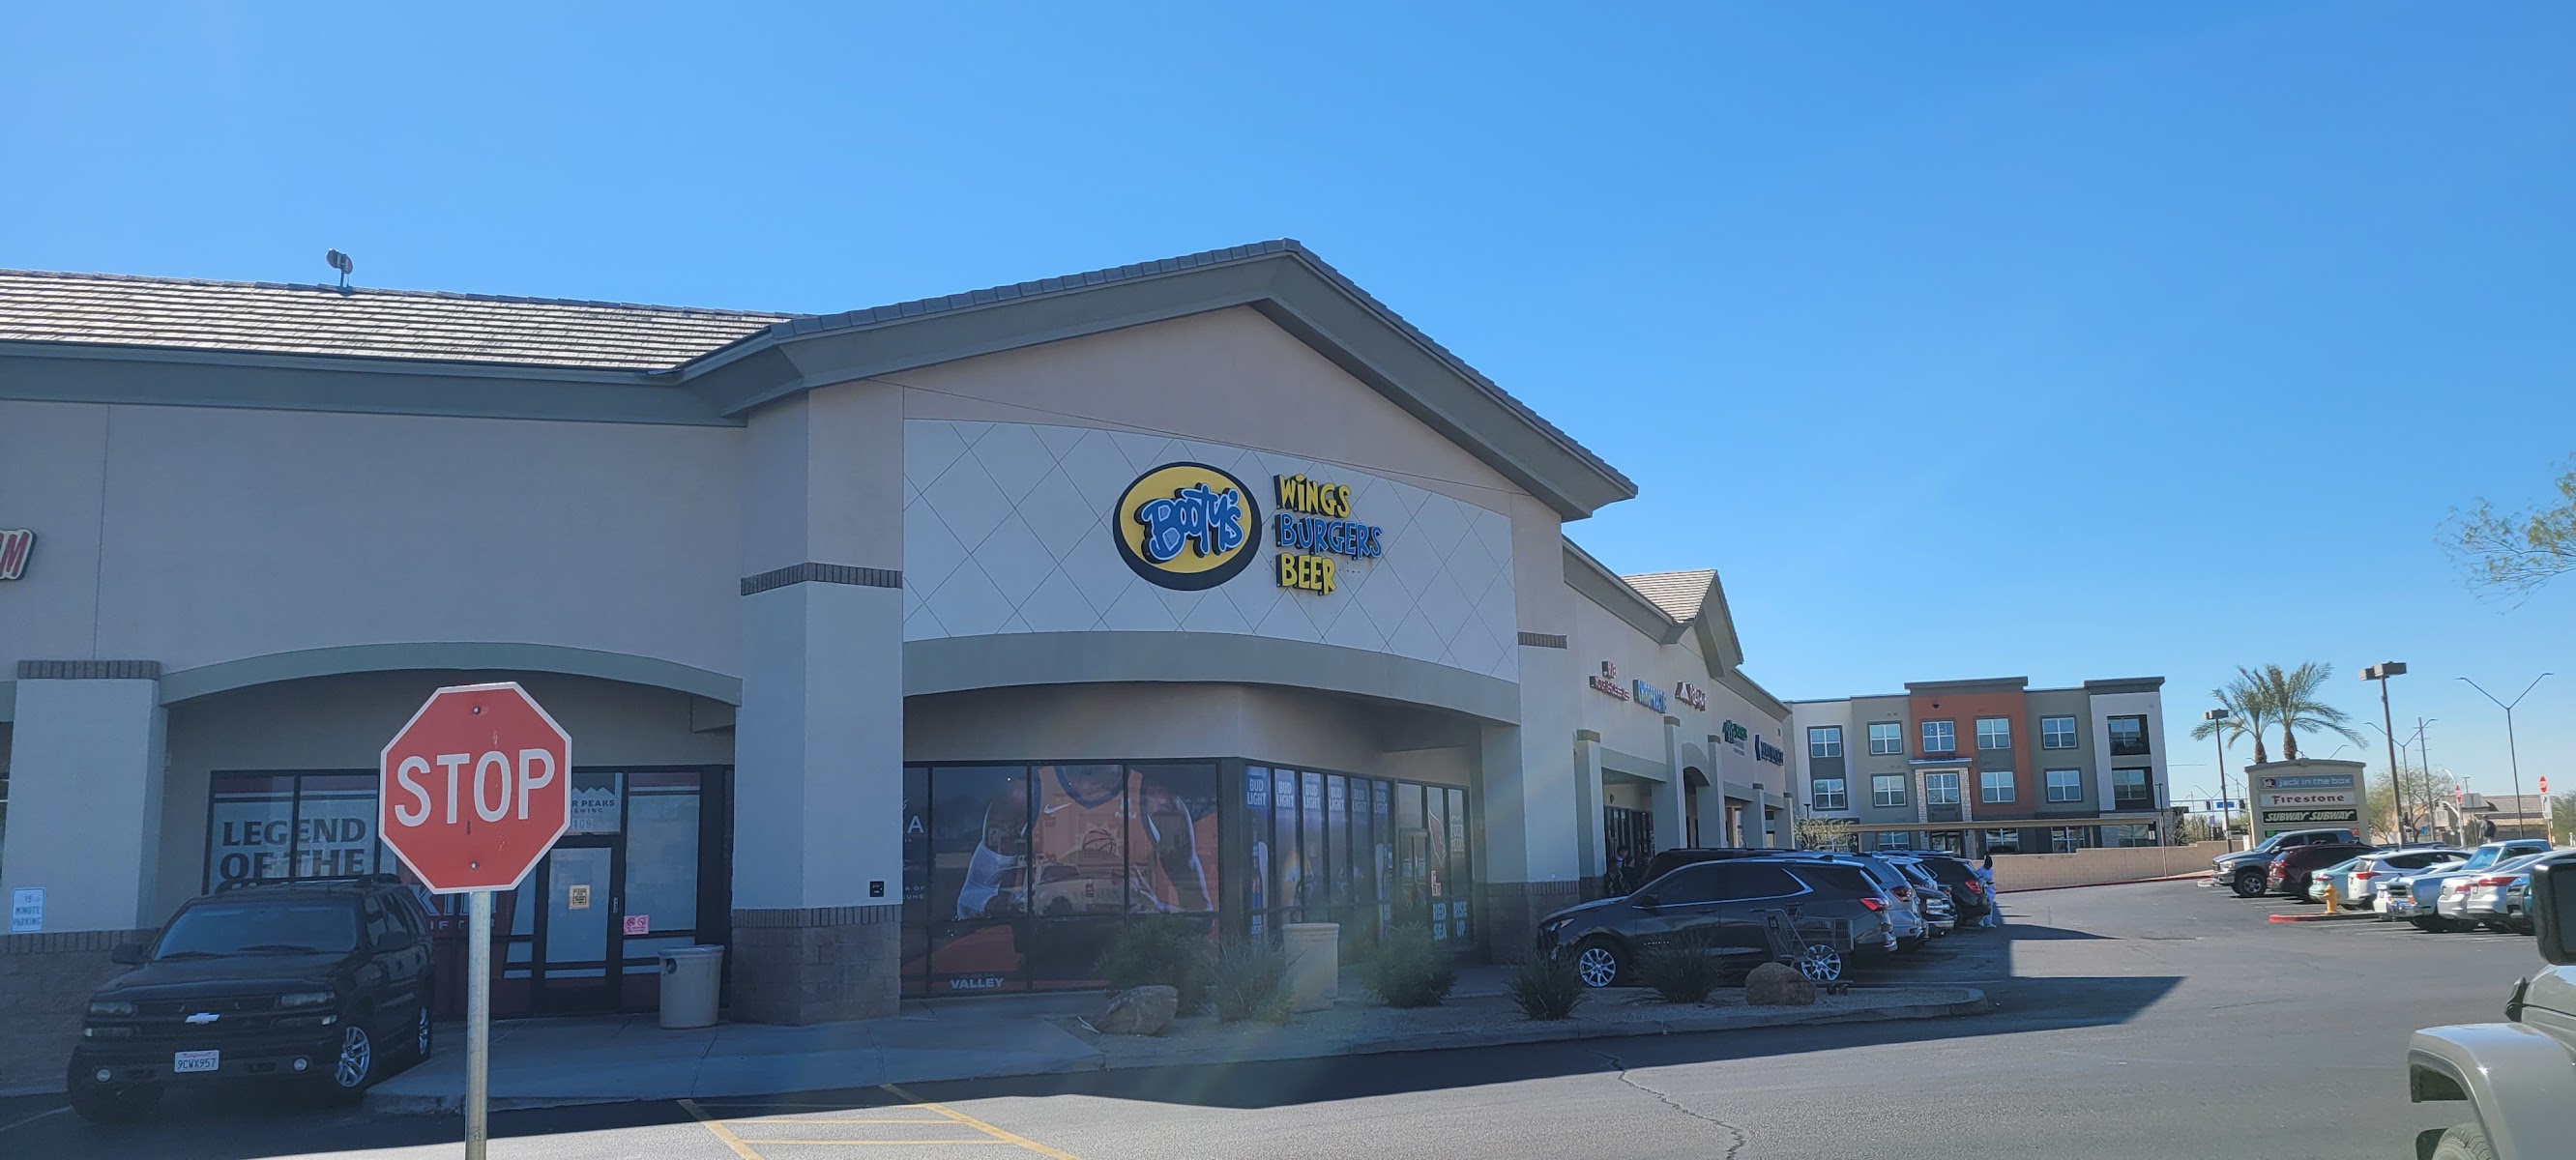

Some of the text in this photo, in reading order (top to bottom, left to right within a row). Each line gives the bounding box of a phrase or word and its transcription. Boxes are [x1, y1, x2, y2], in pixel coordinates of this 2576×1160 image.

[1274, 512, 1384, 561] BURGERS
[1275, 552, 1338, 596] BEER
[395, 748, 555, 827] STOP
[1249, 778, 1264, 792] BUD
[1278, 781, 1292, 795] BUD
[1305, 784, 1318, 797] BUD
[1247, 792, 1267, 805] LIGHT
[1331, 787, 1342, 798] BUD
[1354, 789, 1365, 801] BUD
[1375, 791, 1387, 802] BUD
[1276, 794, 1295, 807] LIGHT
[1303, 797, 1321, 809] LIGHT
[1329, 798, 1345, 812] LIGHT
[1352, 800, 1367, 813] LIGHT
[2271, 795, 2345, 805] Firestone
[1374, 802, 1388, 815] LIGHT
[2265, 811, 2355, 822] SUBWAY SUBWAY
[221, 818, 366, 847] LEGEND
[220, 849, 365, 882] OF THE
[1432, 903, 1447, 921] RED
[1453, 901, 1468, 918] RISE
[1433, 922, 1448, 942] SEA
[1456, 919, 1466, 938] UP
[950, 977, 1005, 989] VALLEY
[177, 1058, 217, 1069] 9CWX957
